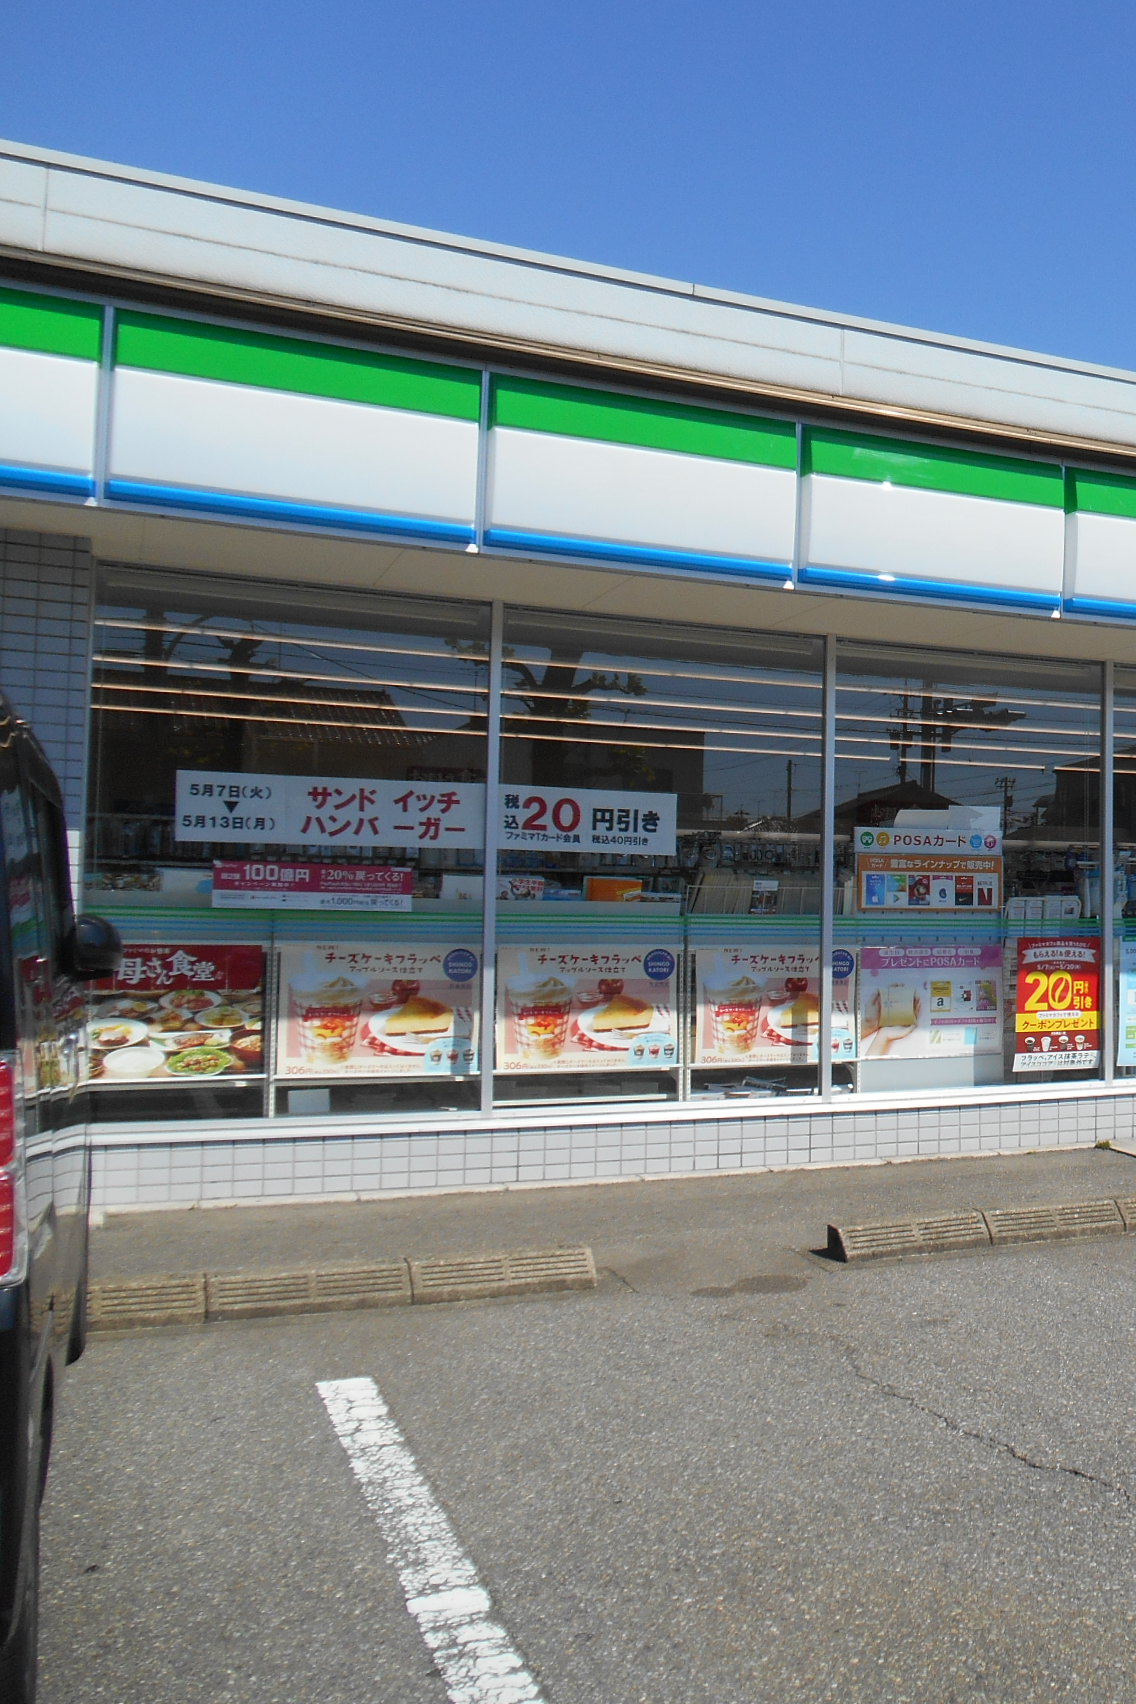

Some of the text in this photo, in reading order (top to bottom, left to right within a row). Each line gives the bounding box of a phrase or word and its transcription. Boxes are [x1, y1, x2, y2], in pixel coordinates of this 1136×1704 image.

[522, 796, 660, 833] 20 円引き
[506, 831, 649, 846] ファミマTカード会員 税込40円引き
[893, 834, 967, 848] POSAカード
[325, 953, 441, 965] チーズケーキフラッペ
[537, 954, 642, 965] チーズケーキフラッペ
[117, 950, 216, 985] 母さん食堂
[1024, 970, 1073, 1012] 20
[1022, 1018, 1094, 1030] クーポンプレゼント
